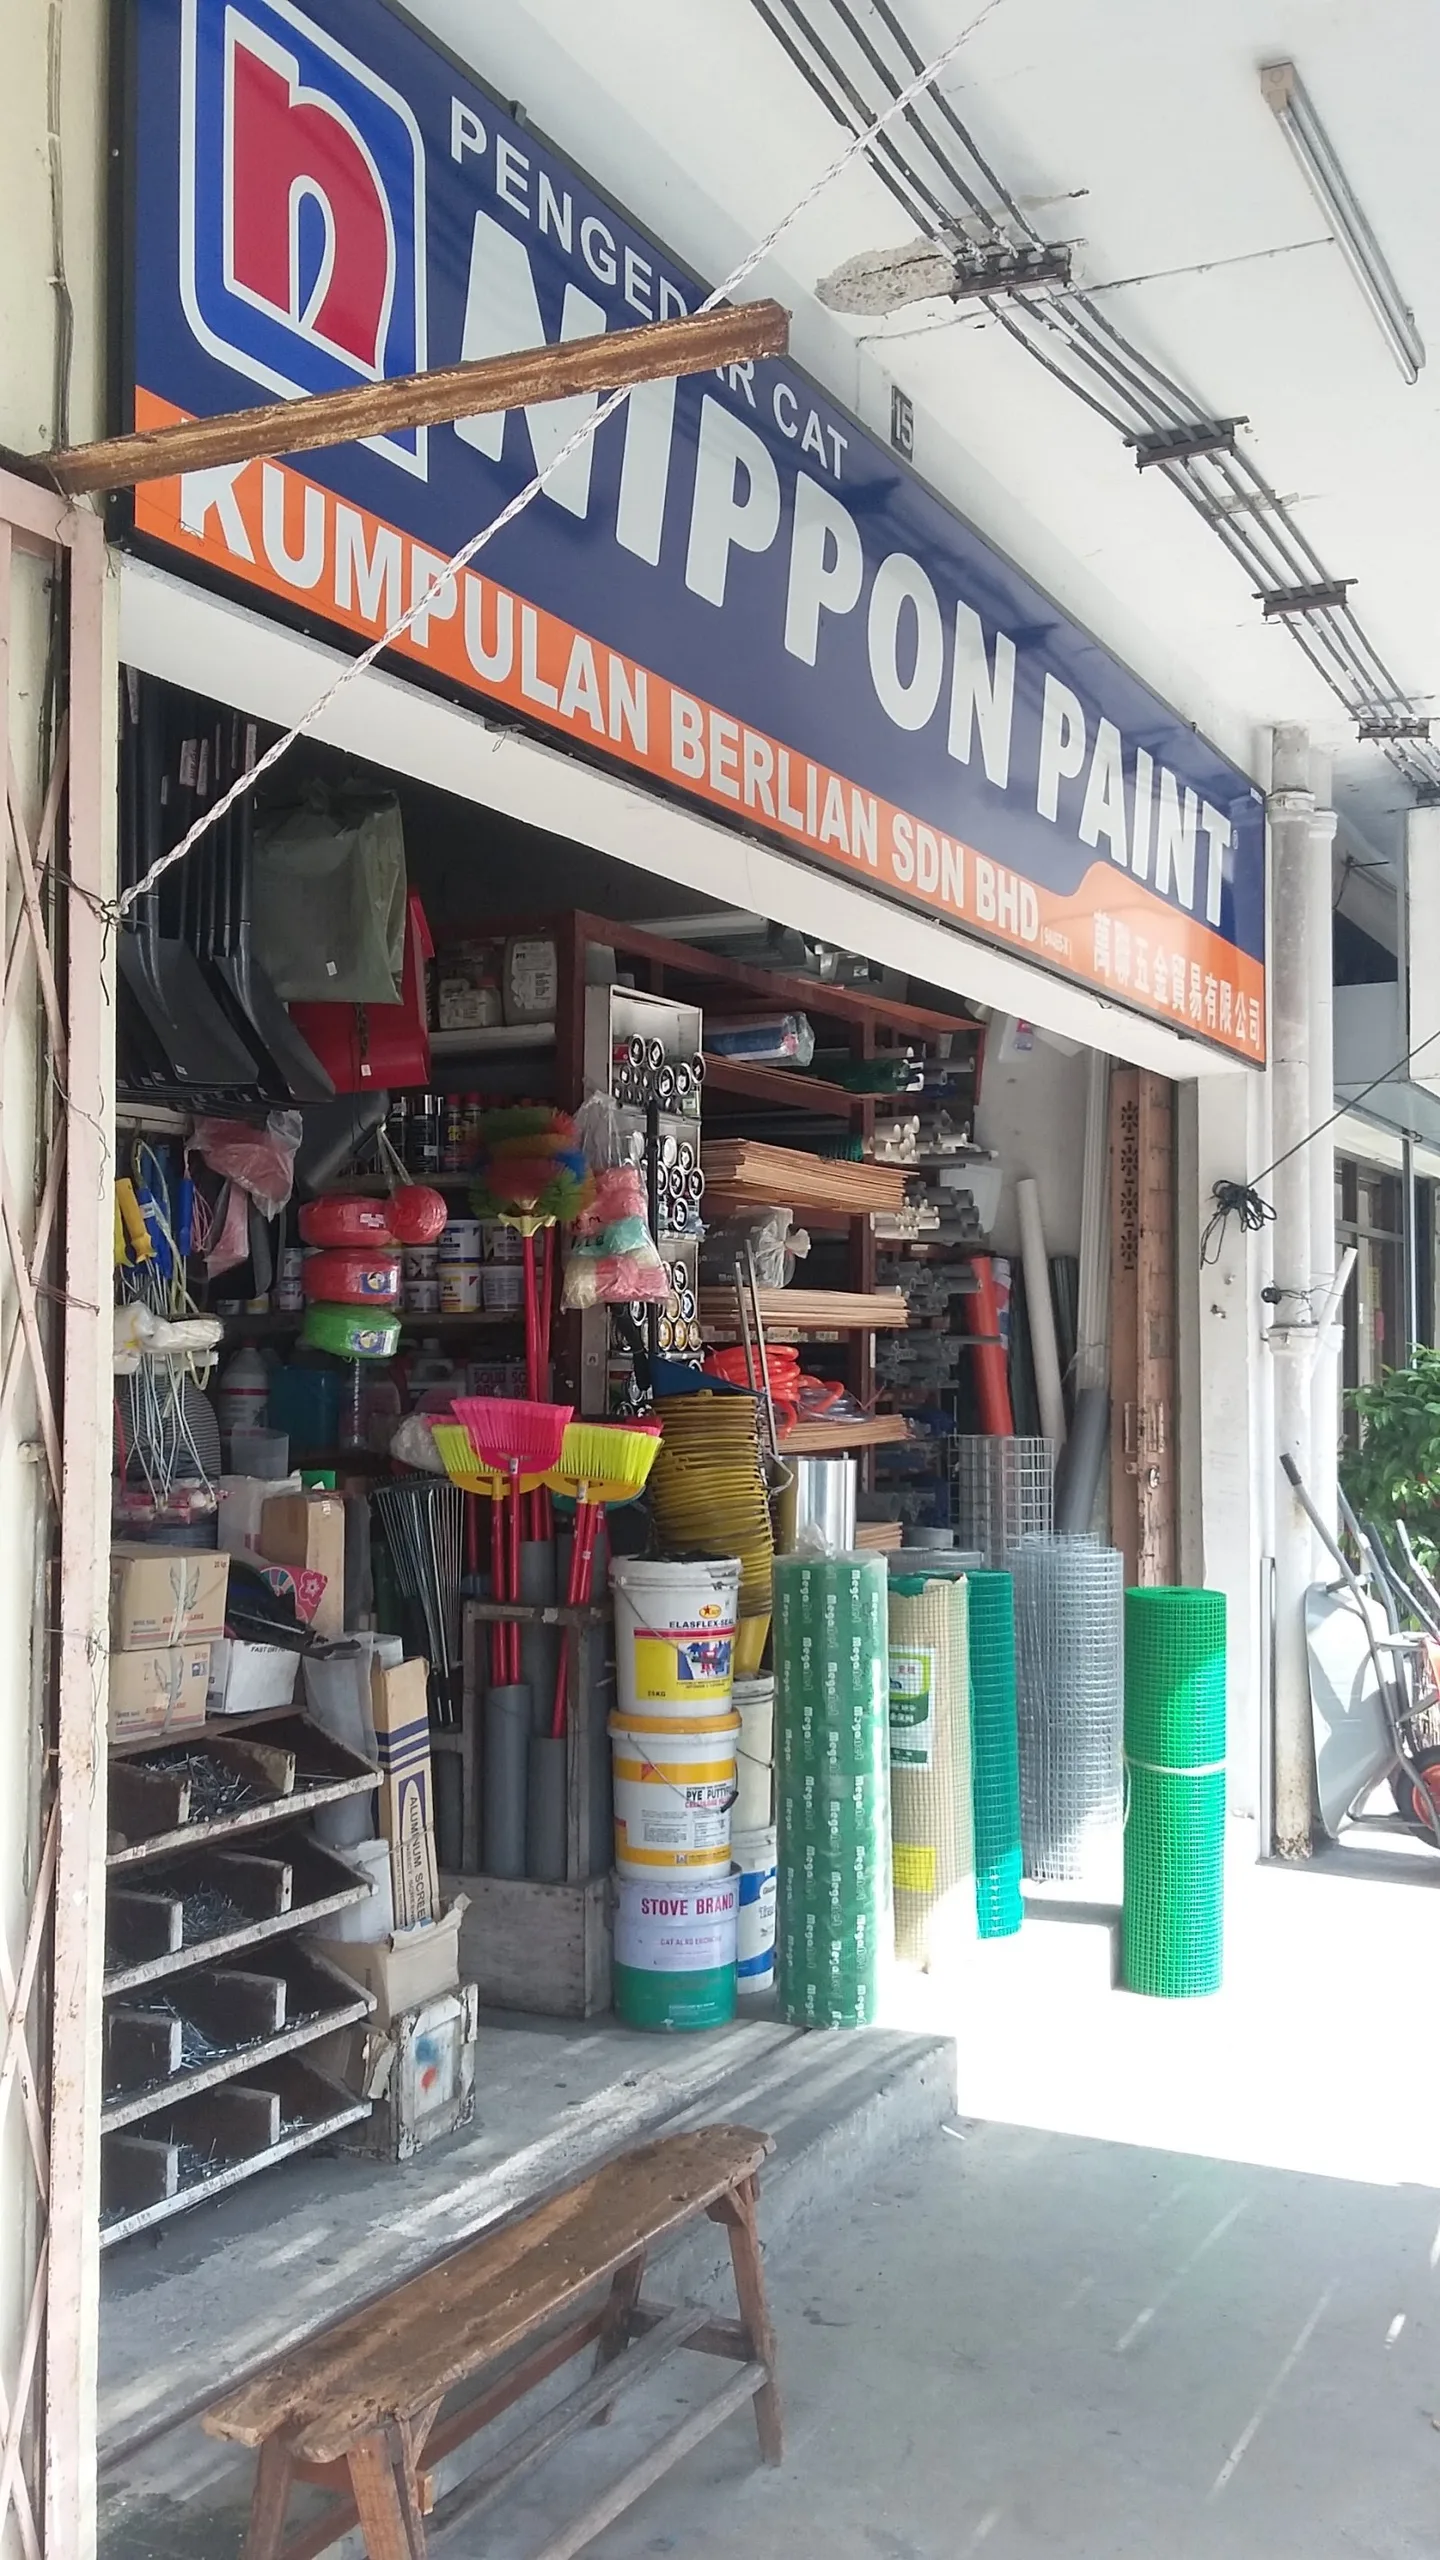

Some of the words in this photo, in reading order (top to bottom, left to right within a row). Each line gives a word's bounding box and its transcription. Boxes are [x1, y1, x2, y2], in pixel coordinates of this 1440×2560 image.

[451, 96, 756, 409] PENGEDR
[773, 383, 848, 480] CAT
[895, 395, 912, 450] 15
[181, 416, 648, 756] KUMPULAN
[671, 688, 878, 866] BERLIAN
[891, 813, 964, 908] SDN
[975, 865, 1038, 942] BHD
[453, 209, 1016, 789] NIPPON
[1036, 672, 1231, 927] PAINT
[641, 1897, 688, 1916] STOVE
[696, 1892, 734, 1915] BRAND
